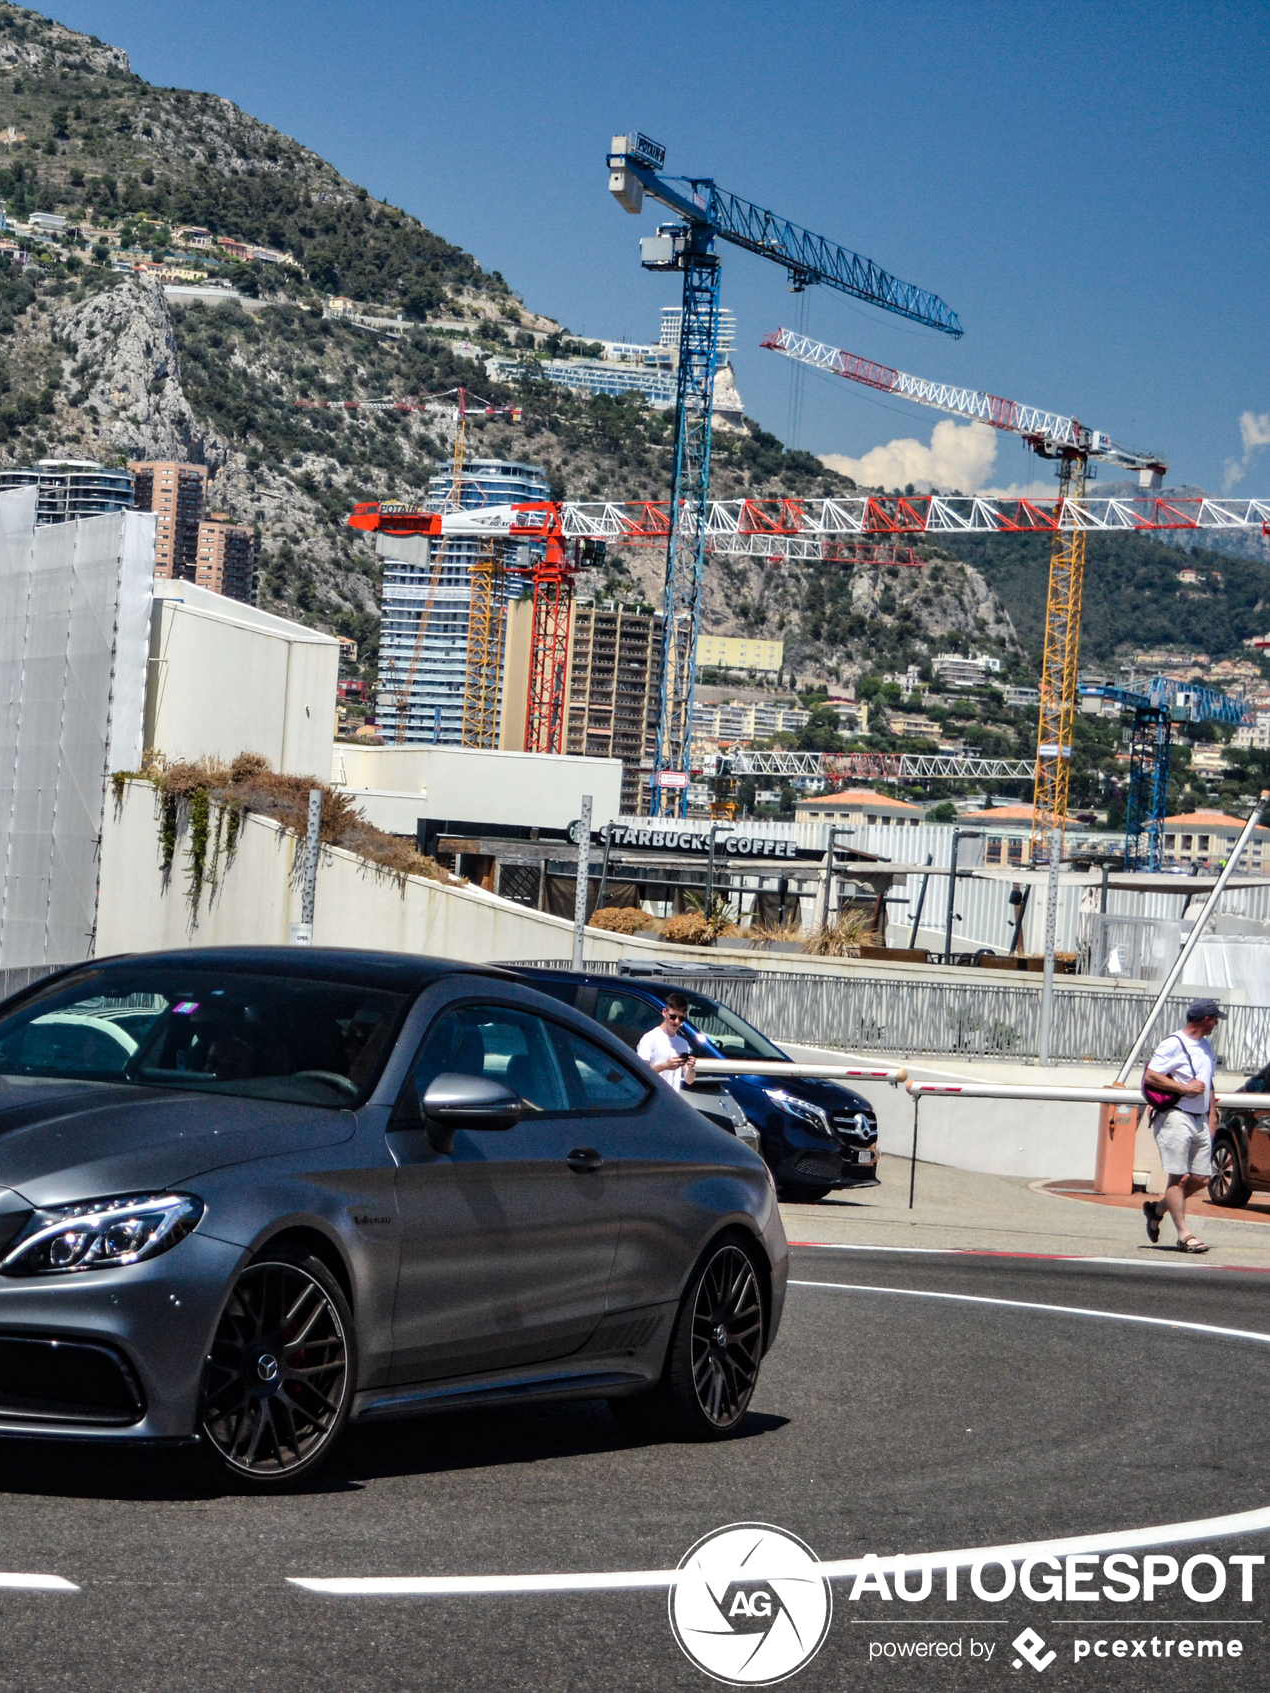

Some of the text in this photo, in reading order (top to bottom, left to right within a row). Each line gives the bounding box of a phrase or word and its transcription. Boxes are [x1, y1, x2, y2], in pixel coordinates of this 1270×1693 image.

[381, 504, 419, 513] POTAIN
[600, 826, 797, 857] STARBUCKS COFFEE
